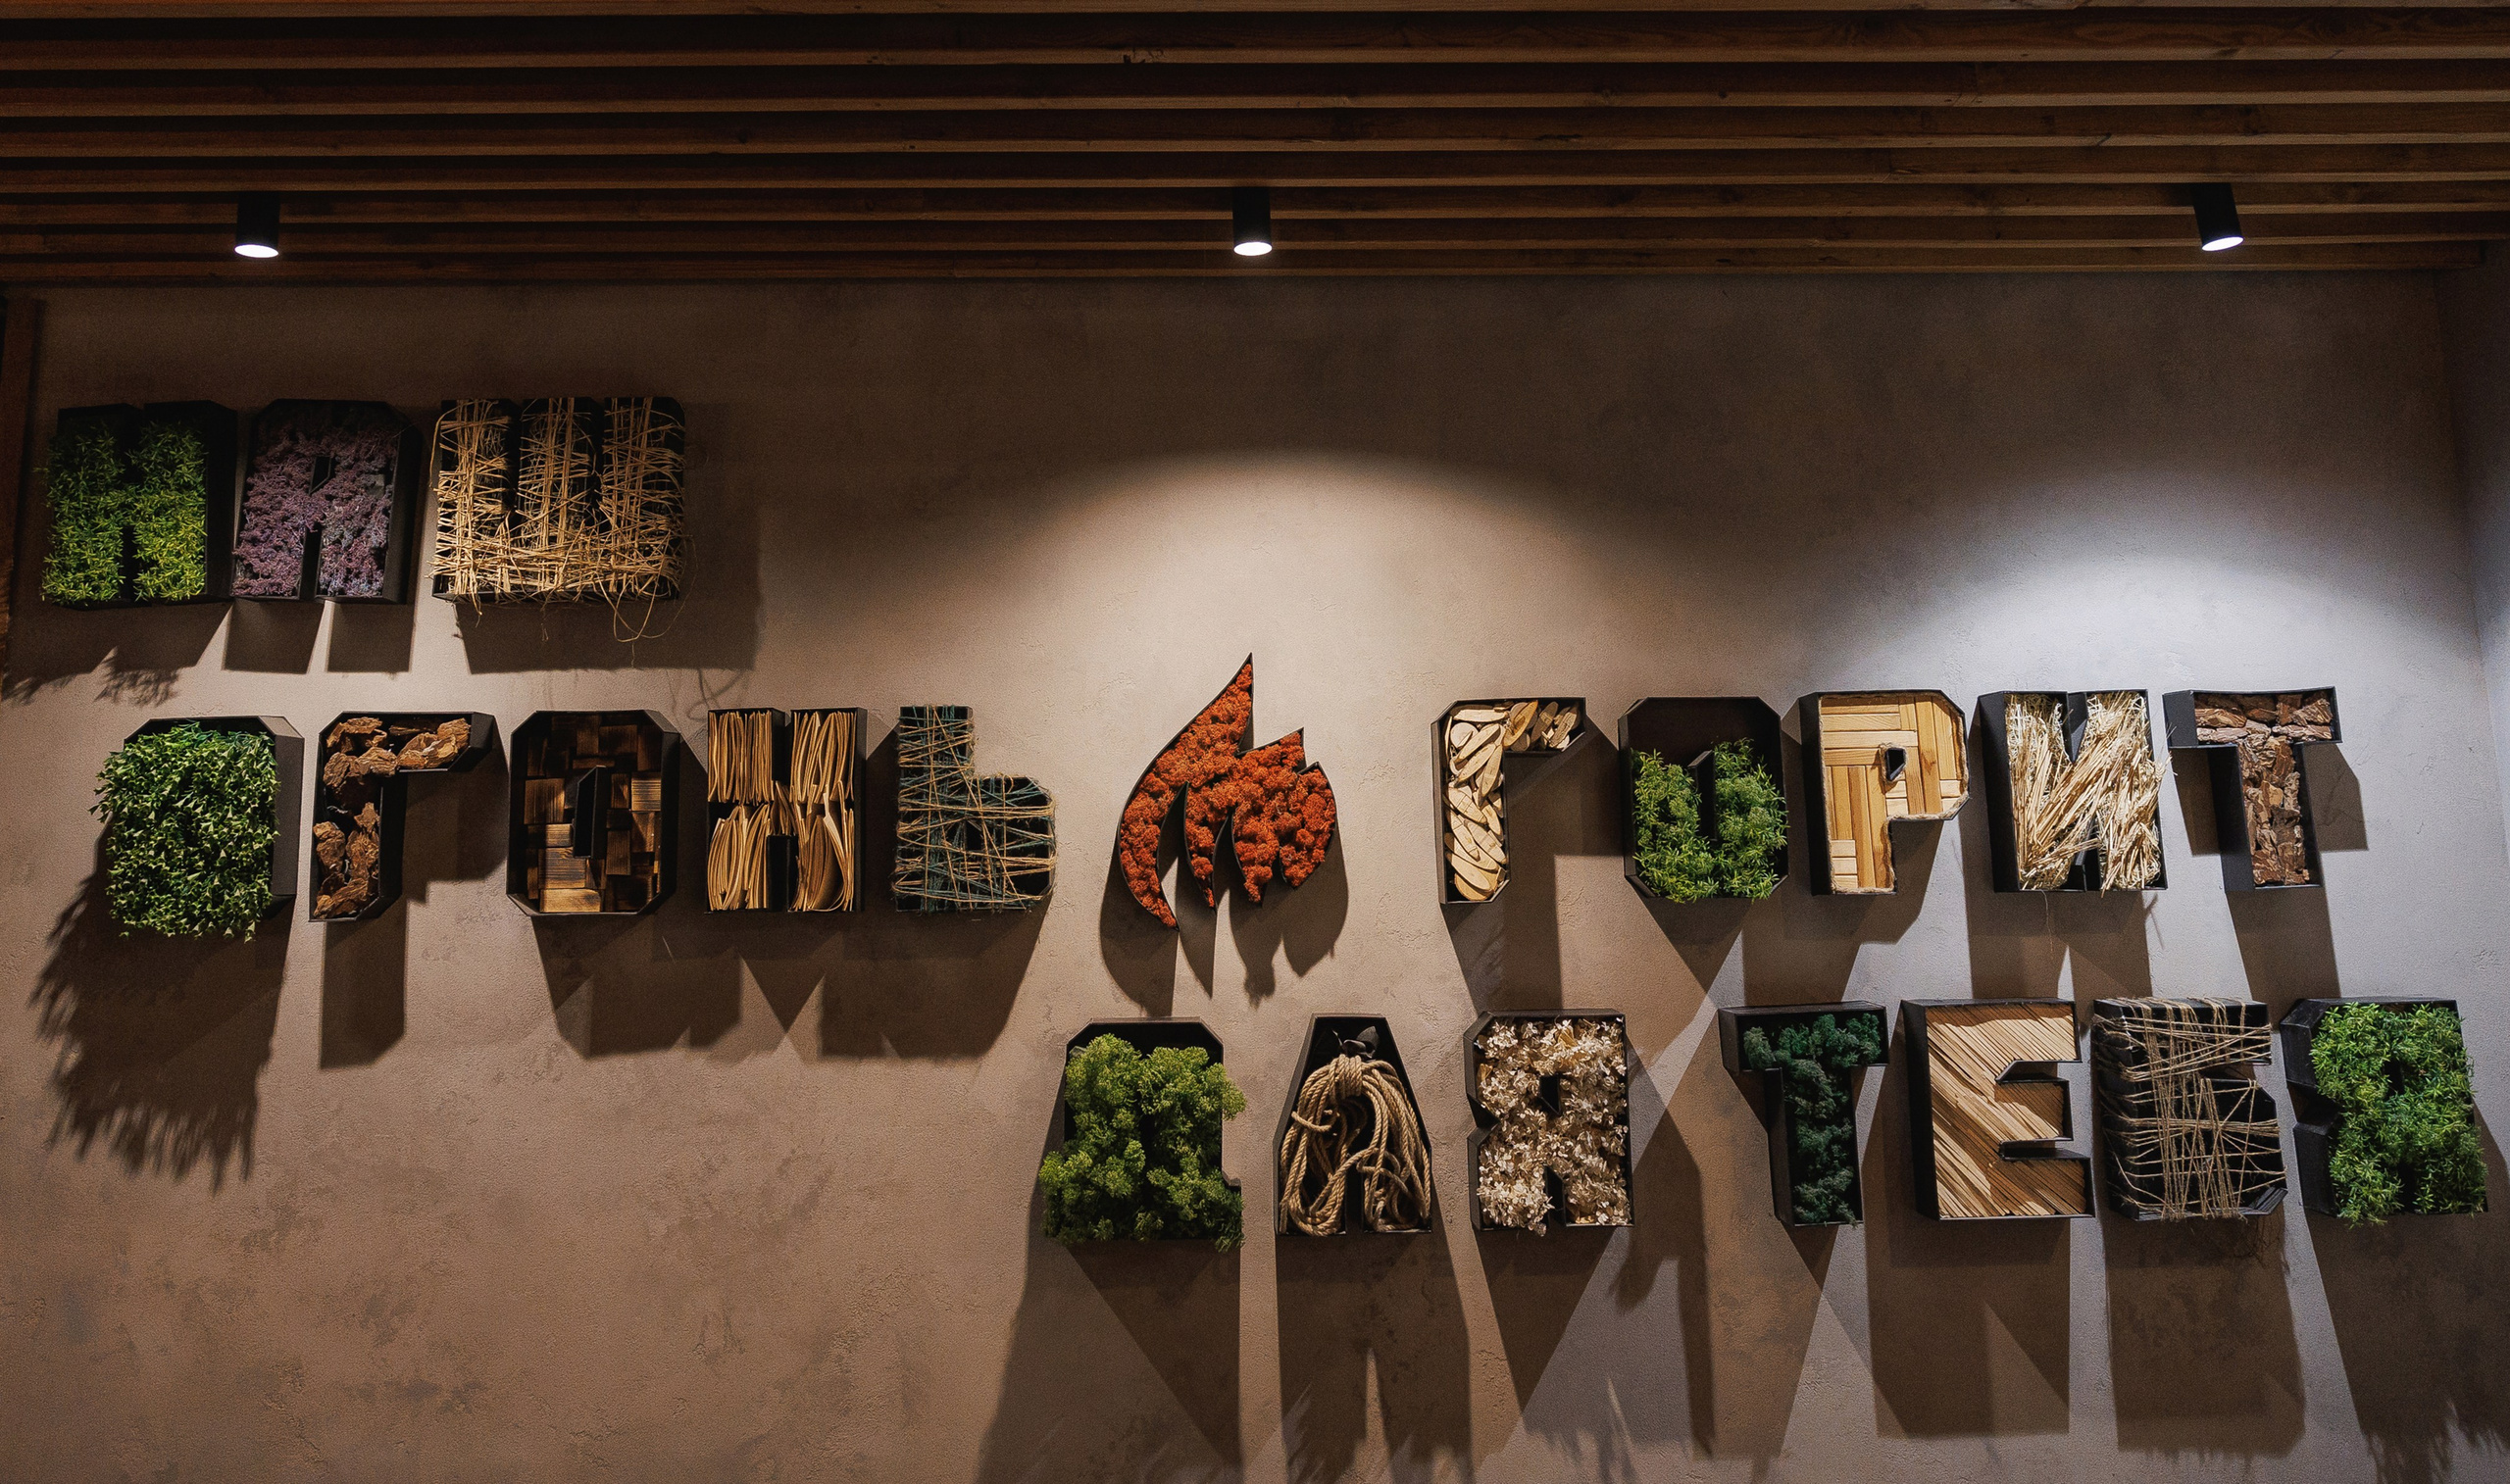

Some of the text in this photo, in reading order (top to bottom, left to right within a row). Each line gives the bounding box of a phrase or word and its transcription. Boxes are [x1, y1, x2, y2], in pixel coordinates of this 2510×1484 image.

[44, 397, 686, 606] НАШ
[94, 687, 2343, 939] ОГОНЬ ГОРИТ
[1041, 997, 2488, 1250] ДЛЯ ТЕБЯ
